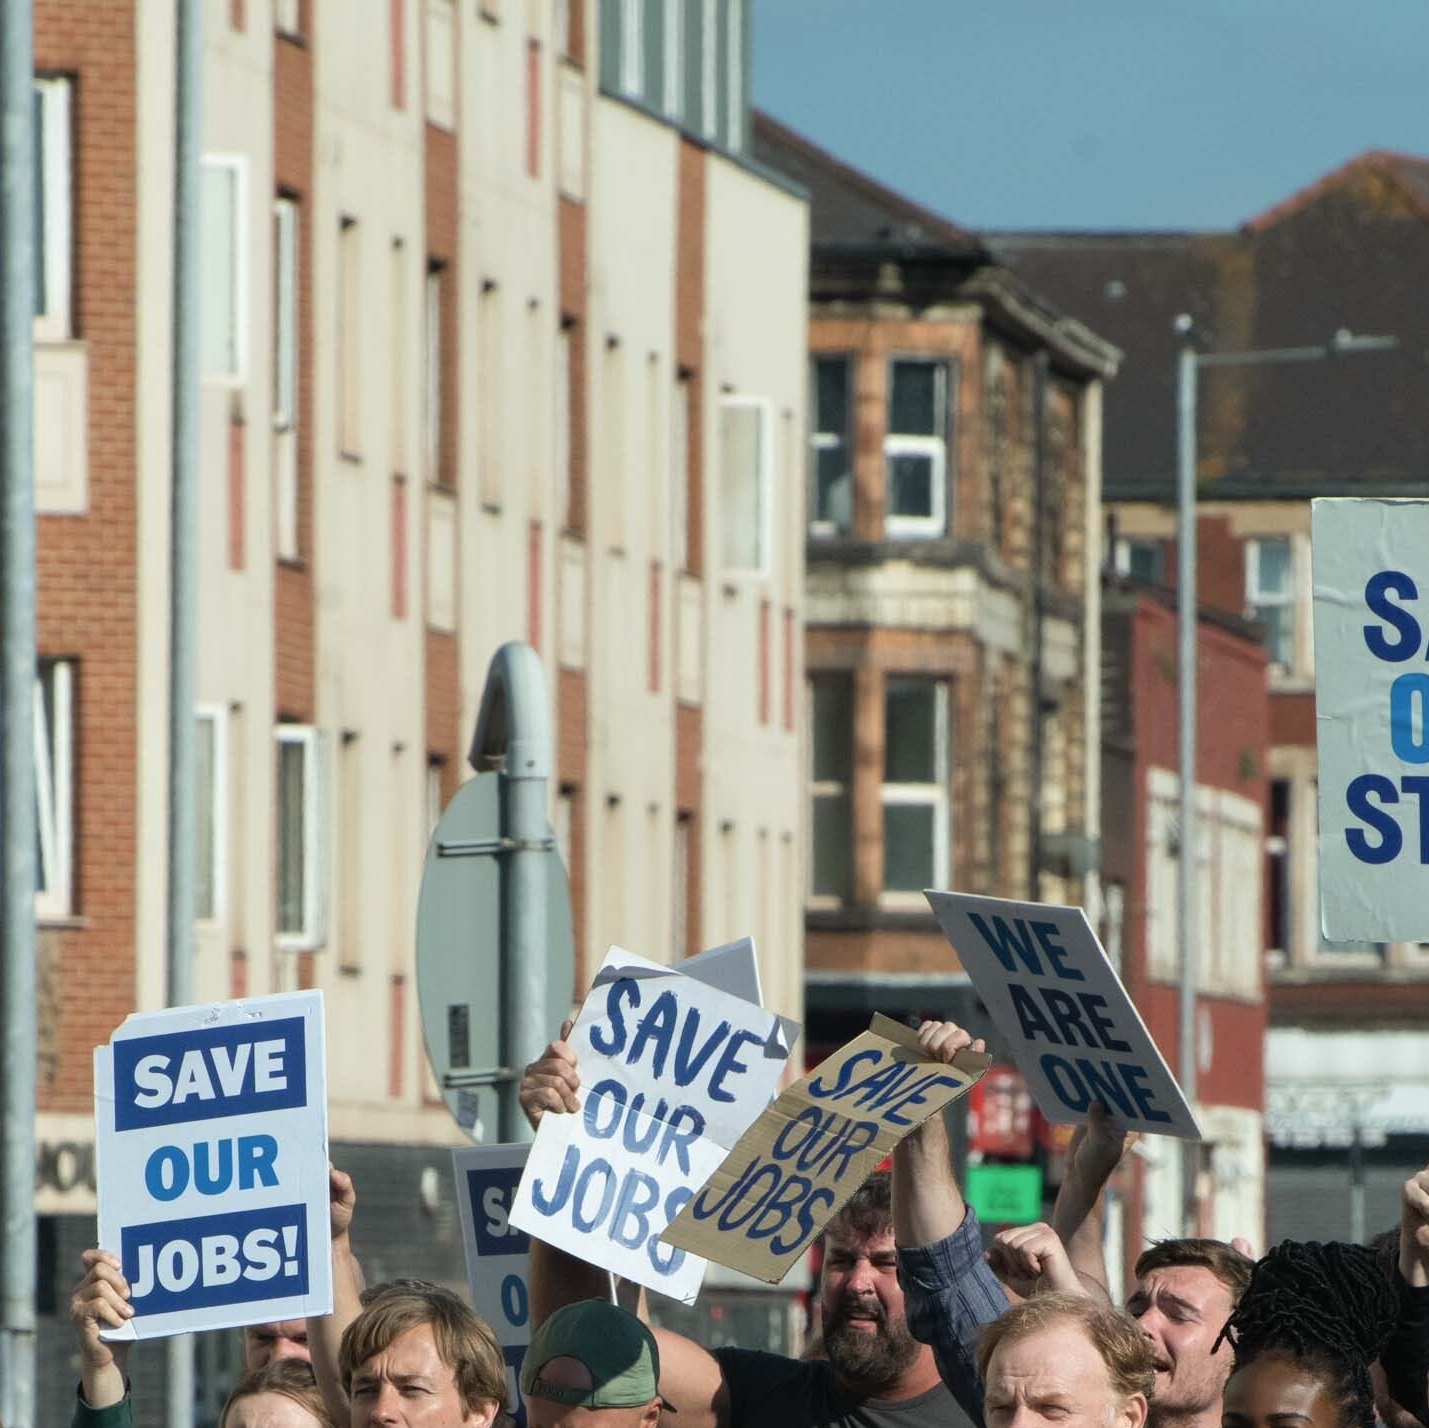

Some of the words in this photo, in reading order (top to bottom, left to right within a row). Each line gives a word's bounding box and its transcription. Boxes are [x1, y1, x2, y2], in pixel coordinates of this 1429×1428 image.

[966, 912, 1085, 981] WE
[589, 977, 767, 1103] SAVE
[1008, 983, 1132, 1052] ARE
[134, 1038, 287, 1109] SAVE
[808, 1049, 964, 1126] SAVE
[1039, 1053, 1172, 1124] ONE
[583, 1079, 706, 1176] OUR
[772, 1106, 879, 1183] OUR
[145, 1134, 280, 1201] OUR
[693, 1155, 835, 1255] JOBS
[532, 1144, 696, 1276] JOBS
[131, 1225, 299, 1298] JOBS!
